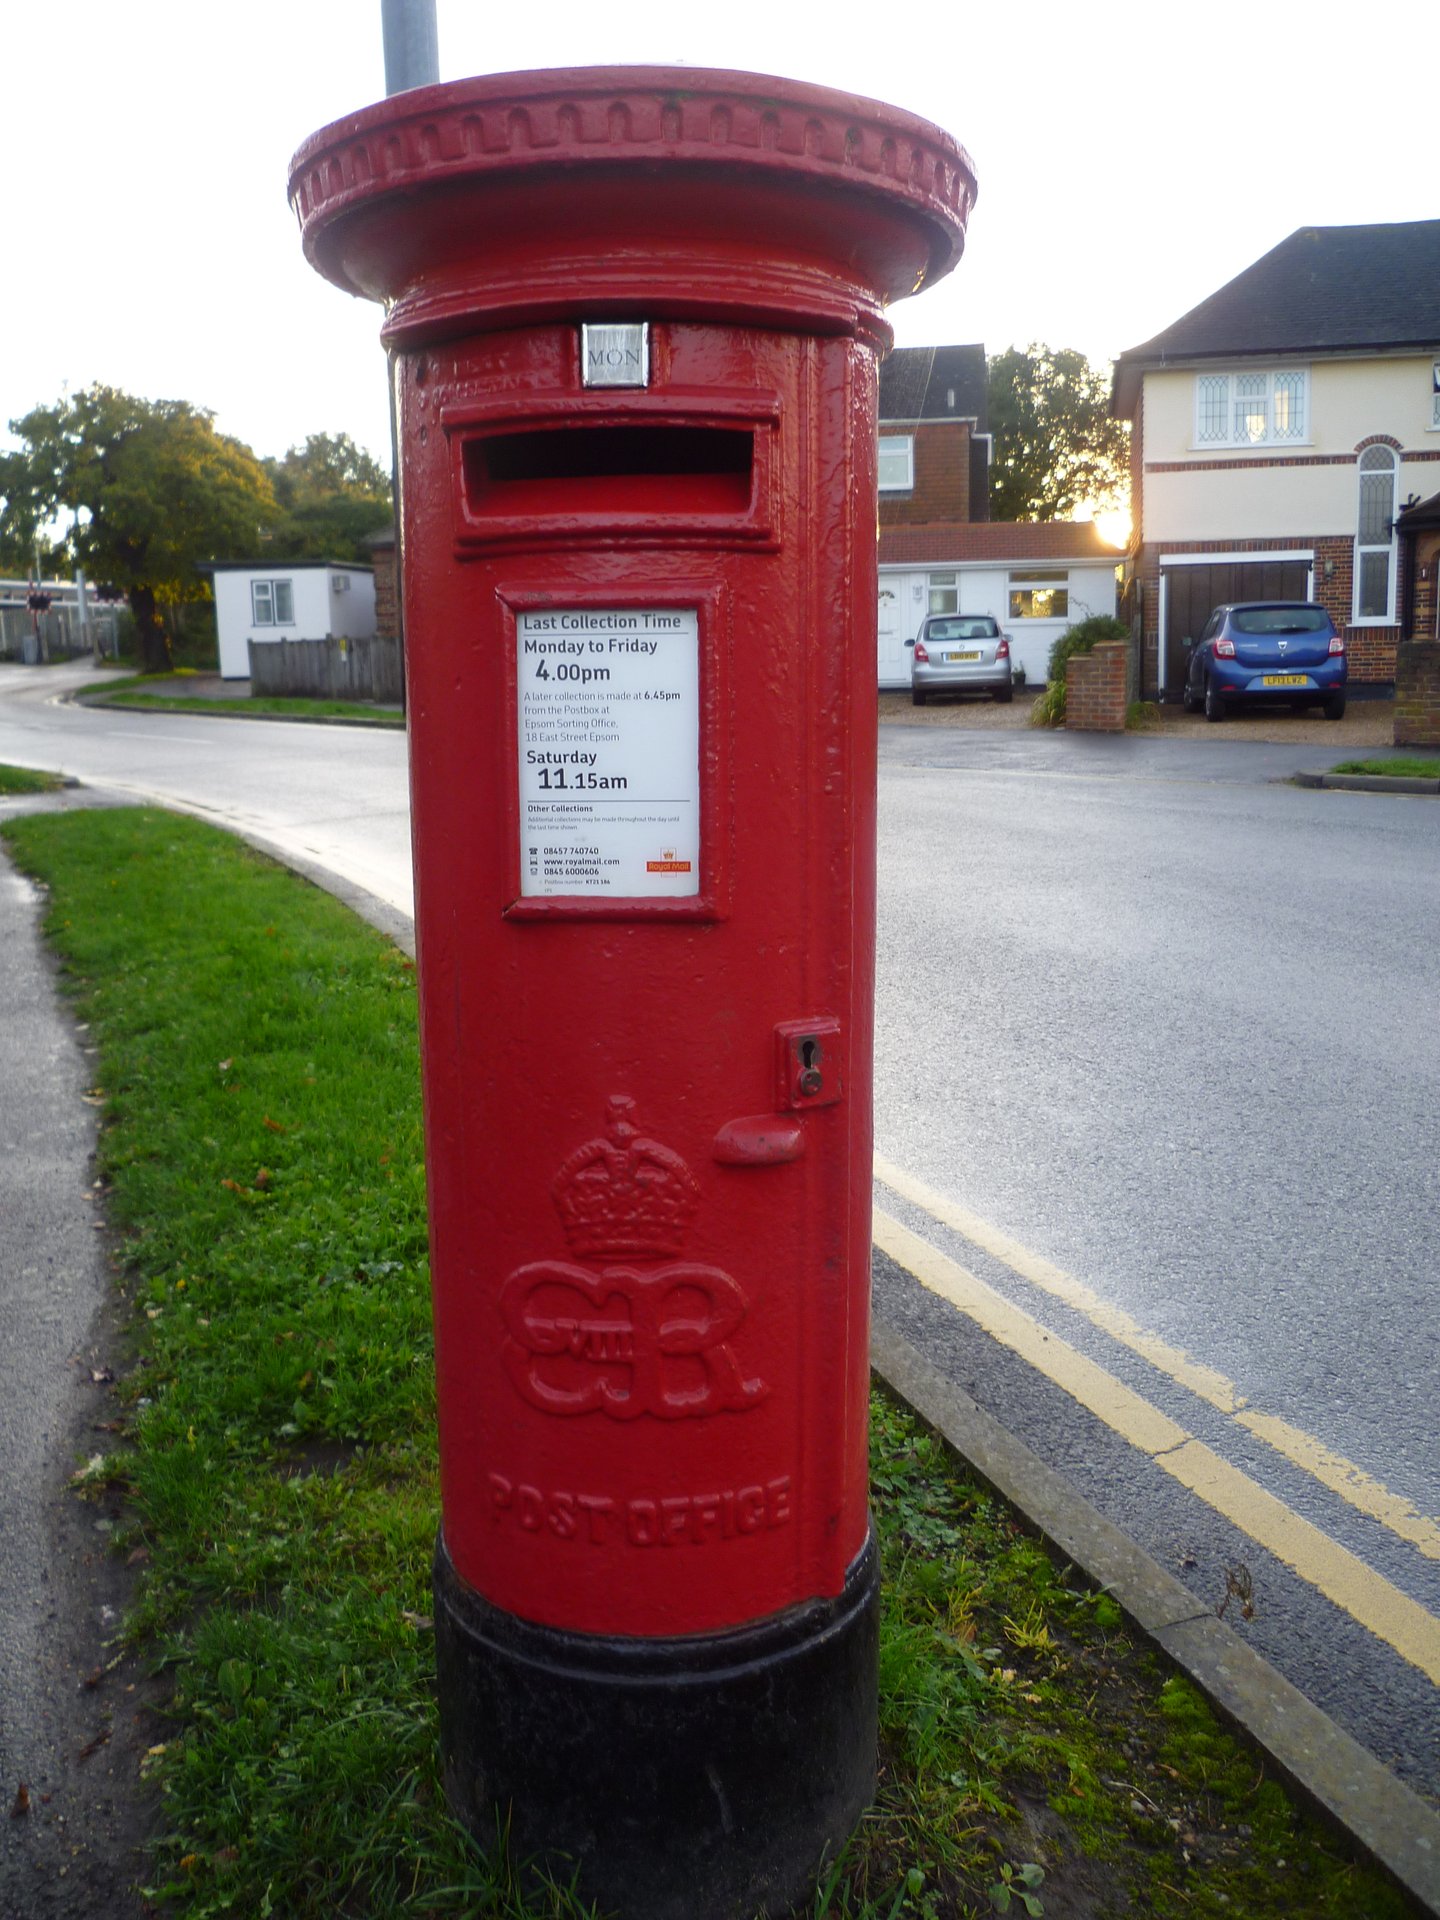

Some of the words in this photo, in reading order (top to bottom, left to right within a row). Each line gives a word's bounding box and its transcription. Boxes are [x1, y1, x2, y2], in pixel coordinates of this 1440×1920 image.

[589, 349, 640, 366] MON
[523, 615, 557, 630] Last
[561, 614, 637, 629] Collection
[641, 614, 681, 628] Time
[524, 639, 585, 656] Monday
[588, 639, 604, 653] to
[608, 638, 658, 656] Friday
[535, 659, 610, 684] 4.00pm
[524, 692, 531, 701] A
[532, 692, 551, 701] later
[554, 691, 596, 701] collection
[597, 691, 605, 700] is
[606, 691, 632, 700] made
[633, 691, 642, 700] at
[644, 690, 681, 702] 6.45pm
[524, 705, 546, 715] from
[548, 705, 562, 714] the
[564, 705, 600, 714] Postbox
[601, 706, 610, 714] at
[525, 719, 555, 730] Epsom
[557, 719, 589, 730] Sorting
[591, 718, 619, 729] Office,
[526, 733, 538, 742] 18
[539, 732, 558, 742] East
[560, 732, 588, 742] Street
[589, 732, 620, 743] Epsom
[526, 750, 597, 767] Saturday
[538, 768, 628, 790] 11.15am
[527, 805, 549, 813] Other
[551, 804, 593, 813] Collections
[582, 817, 593, 825] may
[570, 847, 599, 855] 740740
[544, 857, 620, 867] www.royalmail.com
[648, 862, 671, 871] Royal
[671, 862, 689, 870] Mail
[544, 868, 564, 876] 0845
[565, 868, 599, 876] 6000606
[488, 1472, 614, 1546] POST
[625, 1475, 791, 1546] OFFICE
